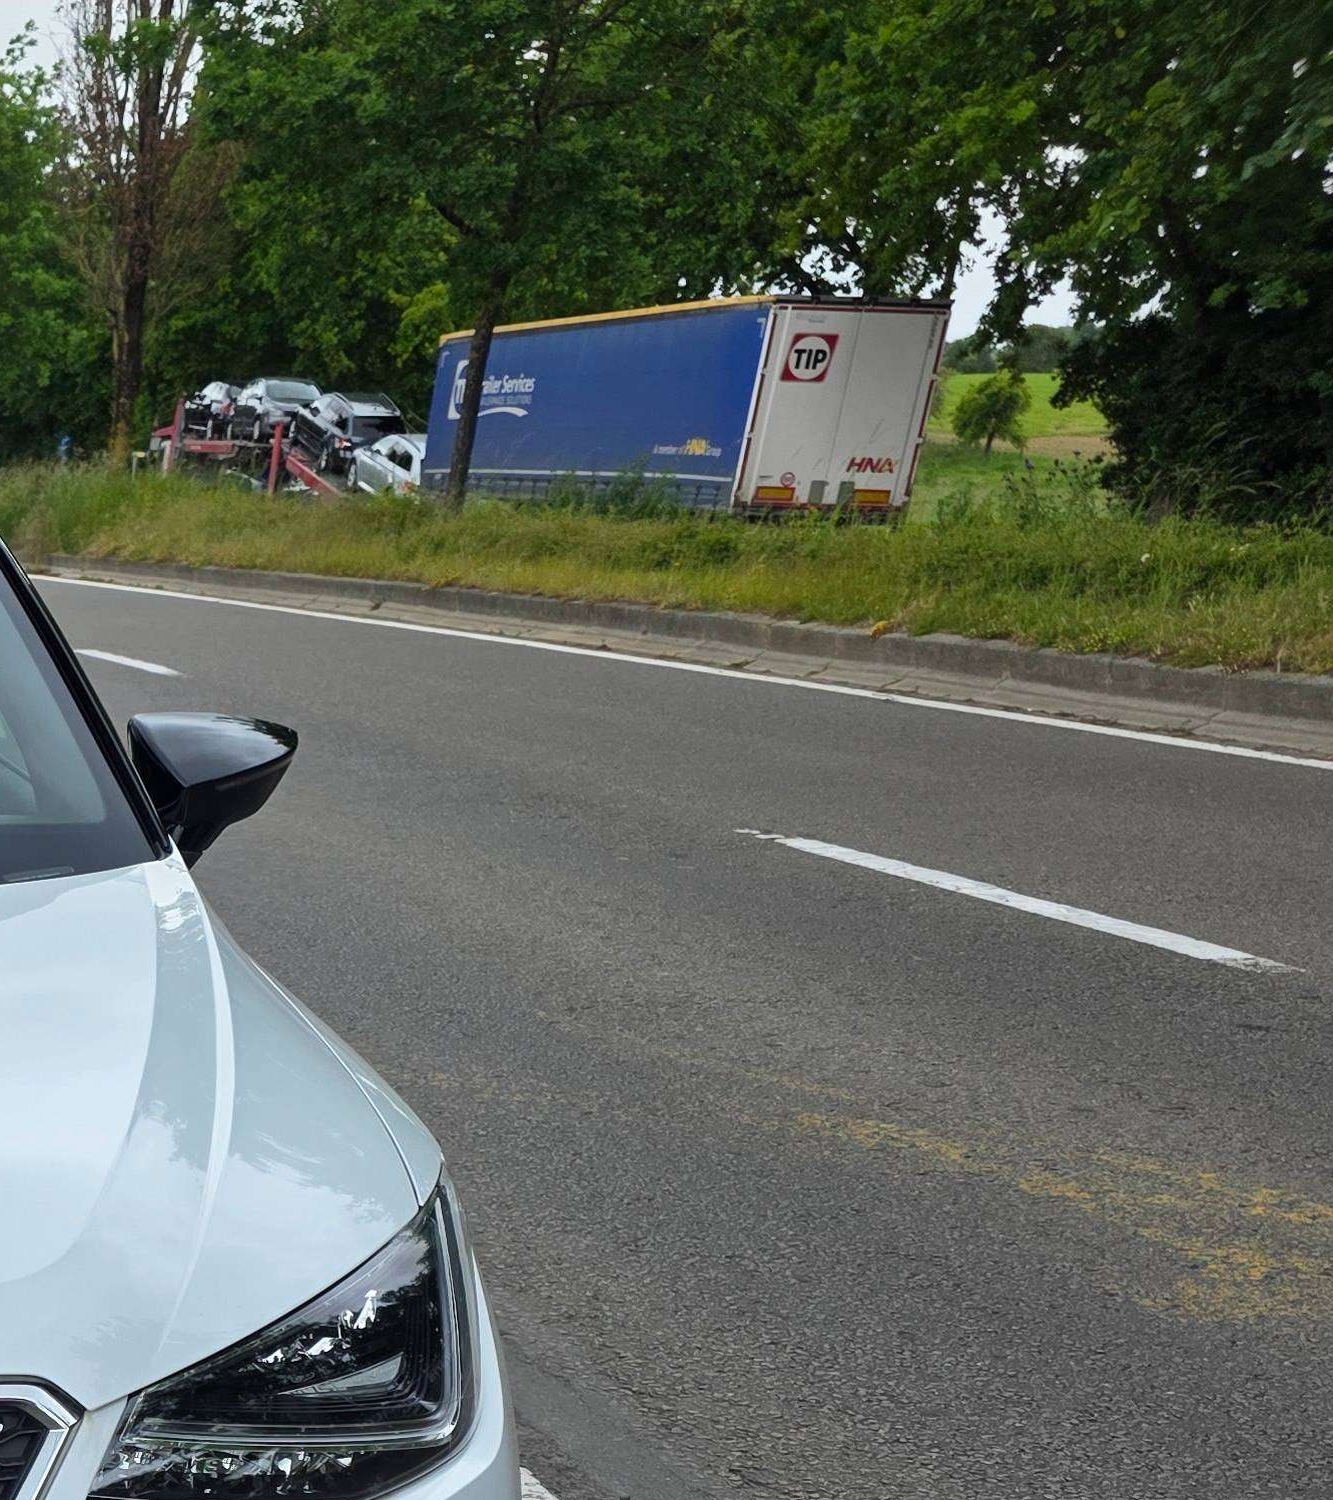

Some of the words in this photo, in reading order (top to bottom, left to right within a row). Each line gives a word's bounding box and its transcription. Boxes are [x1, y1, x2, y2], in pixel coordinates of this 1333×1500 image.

[794, 348, 827, 370] TIP
[501, 374, 535, 393] Services
[846, 456, 895, 474] HNA
